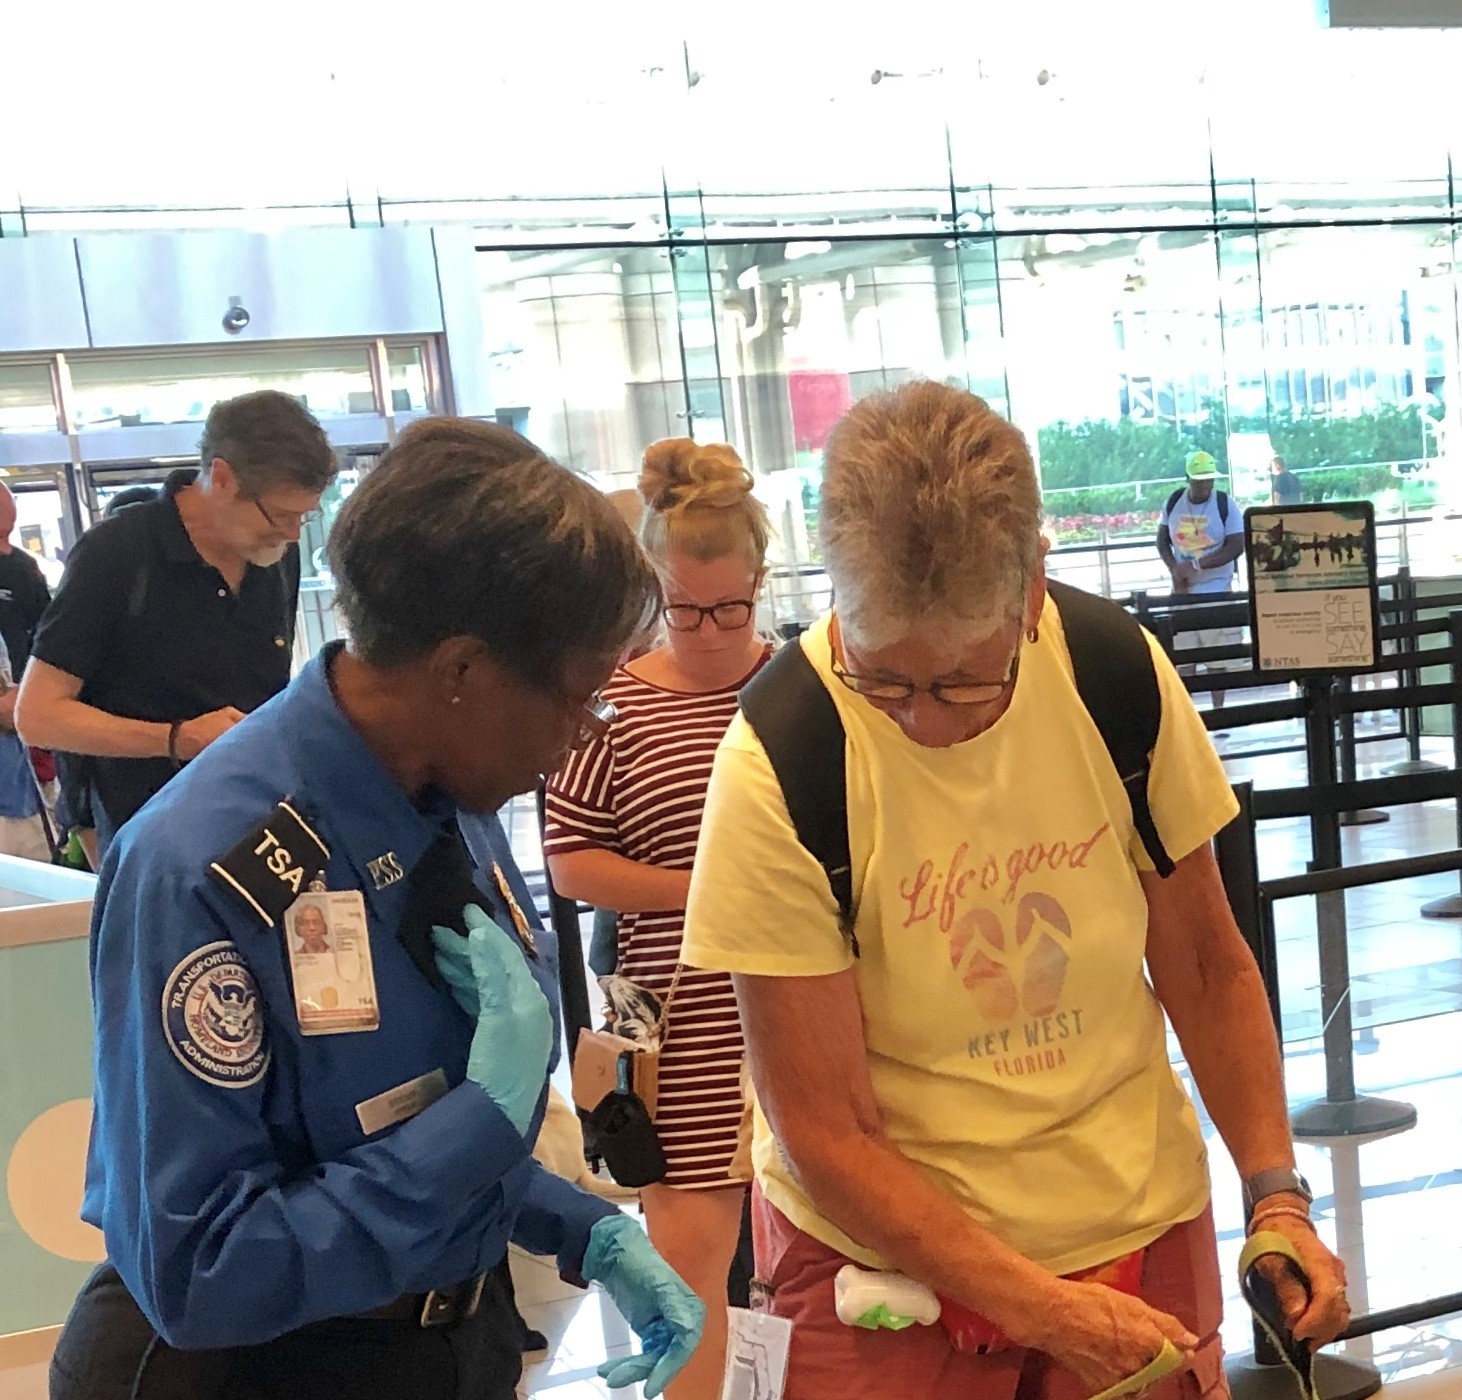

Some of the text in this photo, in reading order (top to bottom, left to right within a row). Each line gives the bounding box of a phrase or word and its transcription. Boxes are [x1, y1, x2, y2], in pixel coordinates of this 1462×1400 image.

[1323, 601, 1365, 625] SEE
[1326, 632, 1369, 655] SAY
[253, 828, 305, 894] TSA
[899, 842, 976, 933] Life
[1002, 821, 1110, 906] good
[967, 1008, 1084, 1059] KEY WEST
[993, 1049, 1066, 1077] FLORIDA
